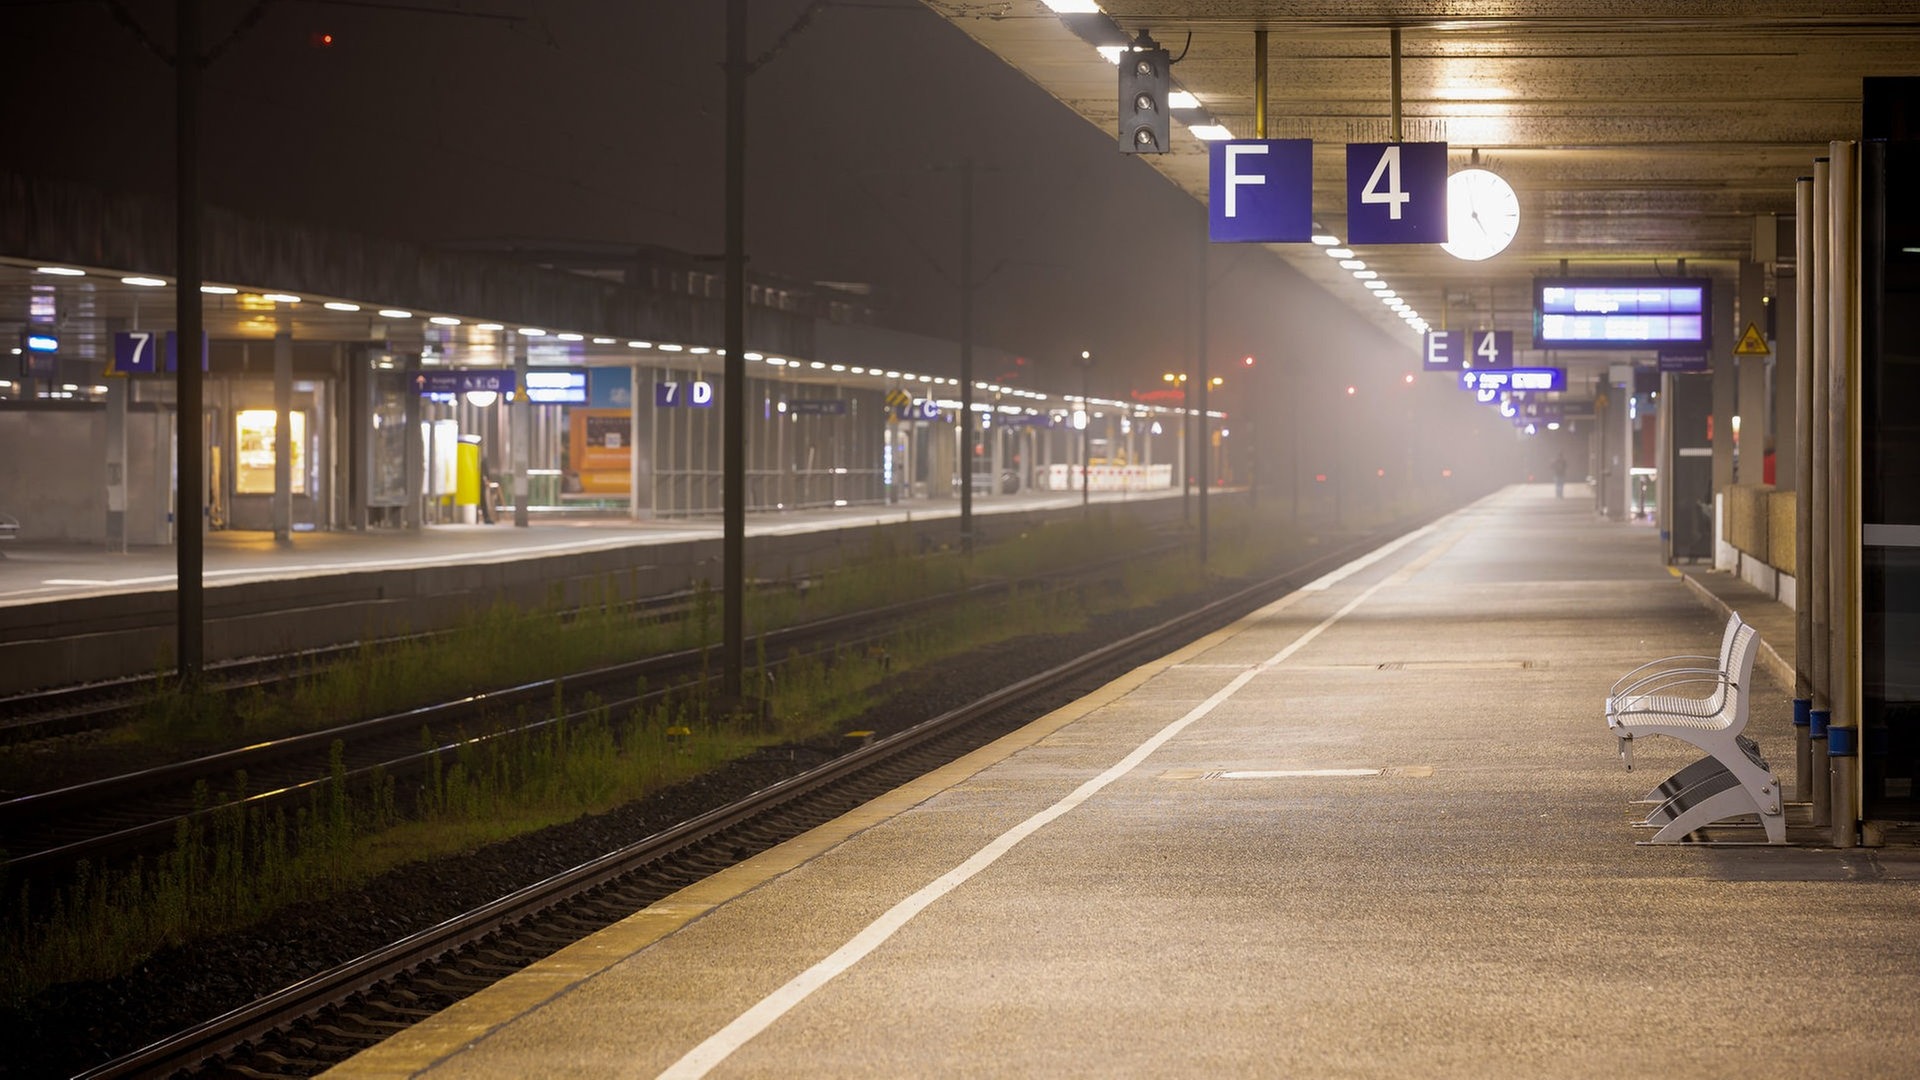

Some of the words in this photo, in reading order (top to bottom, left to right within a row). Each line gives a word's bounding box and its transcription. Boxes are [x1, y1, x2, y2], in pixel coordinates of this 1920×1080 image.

[1224, 144, 1269, 217] F
[1361, 145, 1410, 220] 4
[129, 332, 149, 363] 7
[1428, 331, 1449, 363] E
[1477, 331, 1499, 363] 4
[664, 381, 678, 403] 7
[693, 381, 712, 403] D
[923, 400, 937, 417] C
